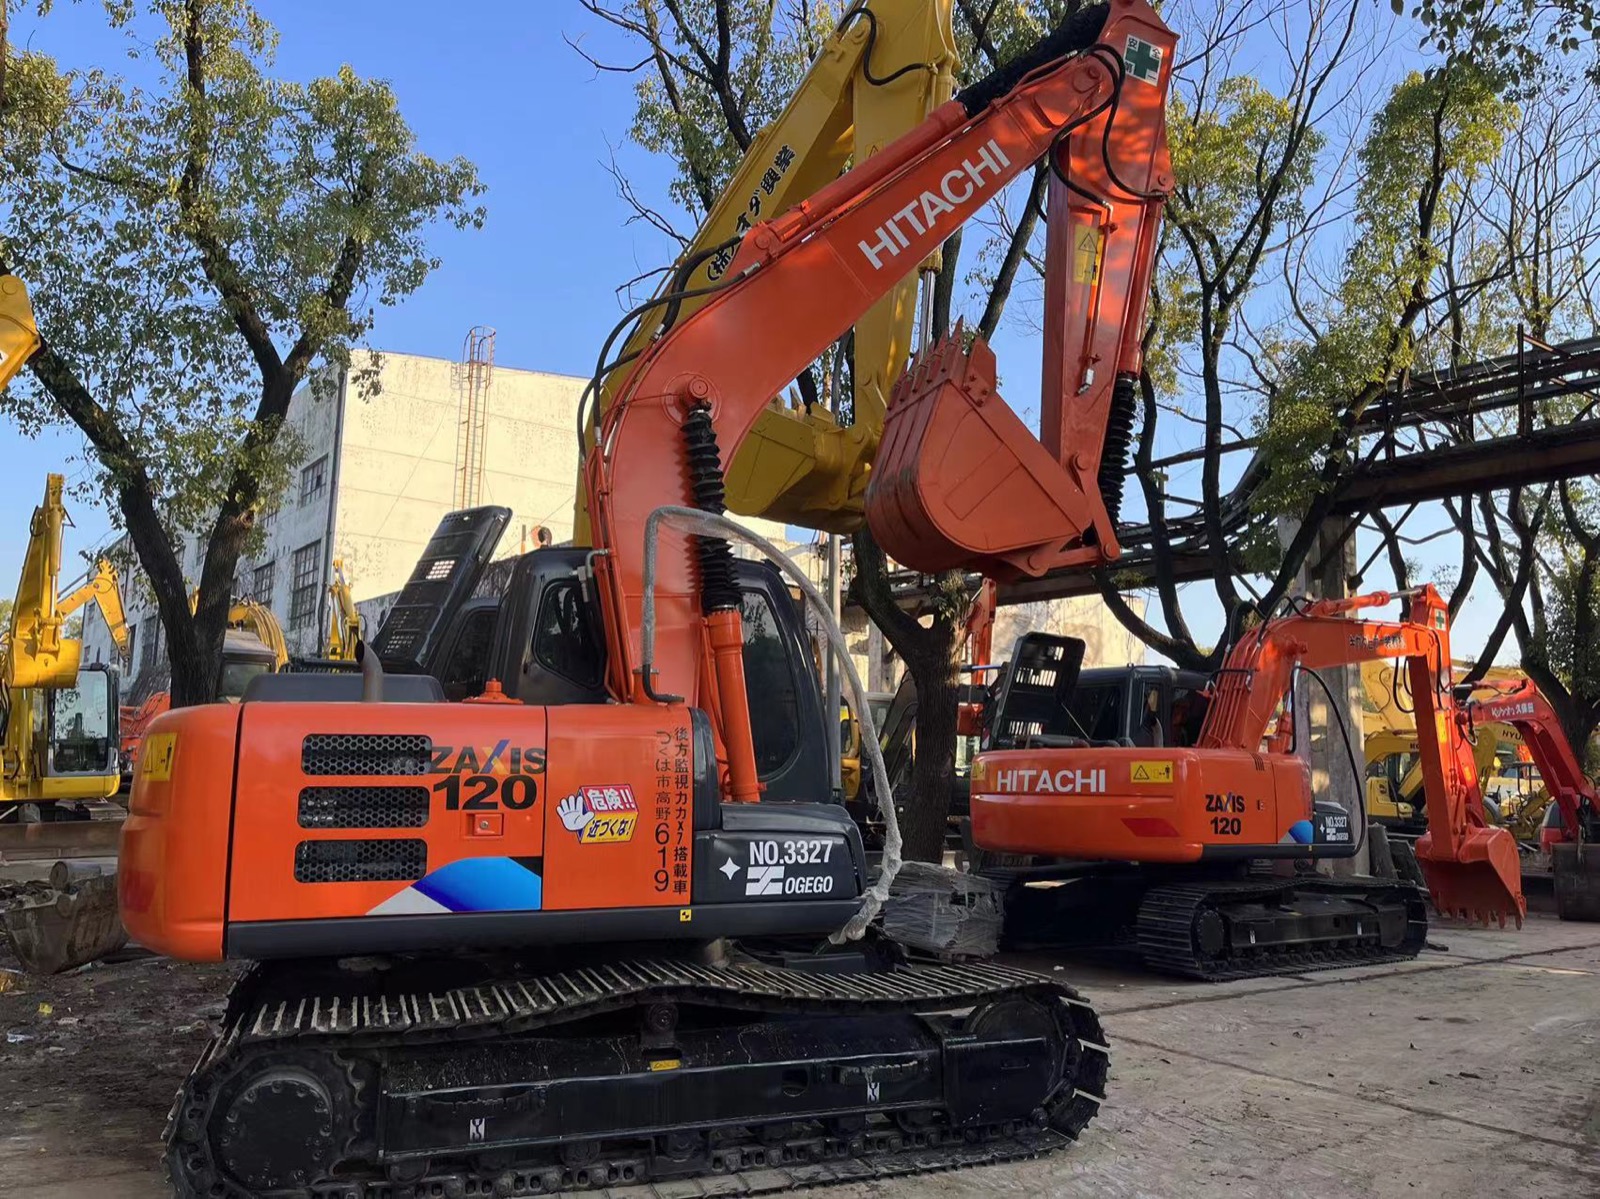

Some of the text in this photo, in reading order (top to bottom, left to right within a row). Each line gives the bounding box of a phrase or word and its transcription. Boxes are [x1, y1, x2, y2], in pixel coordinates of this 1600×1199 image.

[857, 139, 1011, 270] HITACHI
[426, 739, 546, 775] ZAXIS
[432, 775, 537, 811] 120
[996, 769, 1106, 793] HITACHI
[1205, 792, 1245, 813] ZAXIS
[1210, 816, 1241, 835] 120
[749, 840, 833, 865] NO.3327
[785, 876, 834, 894] OGEGO
